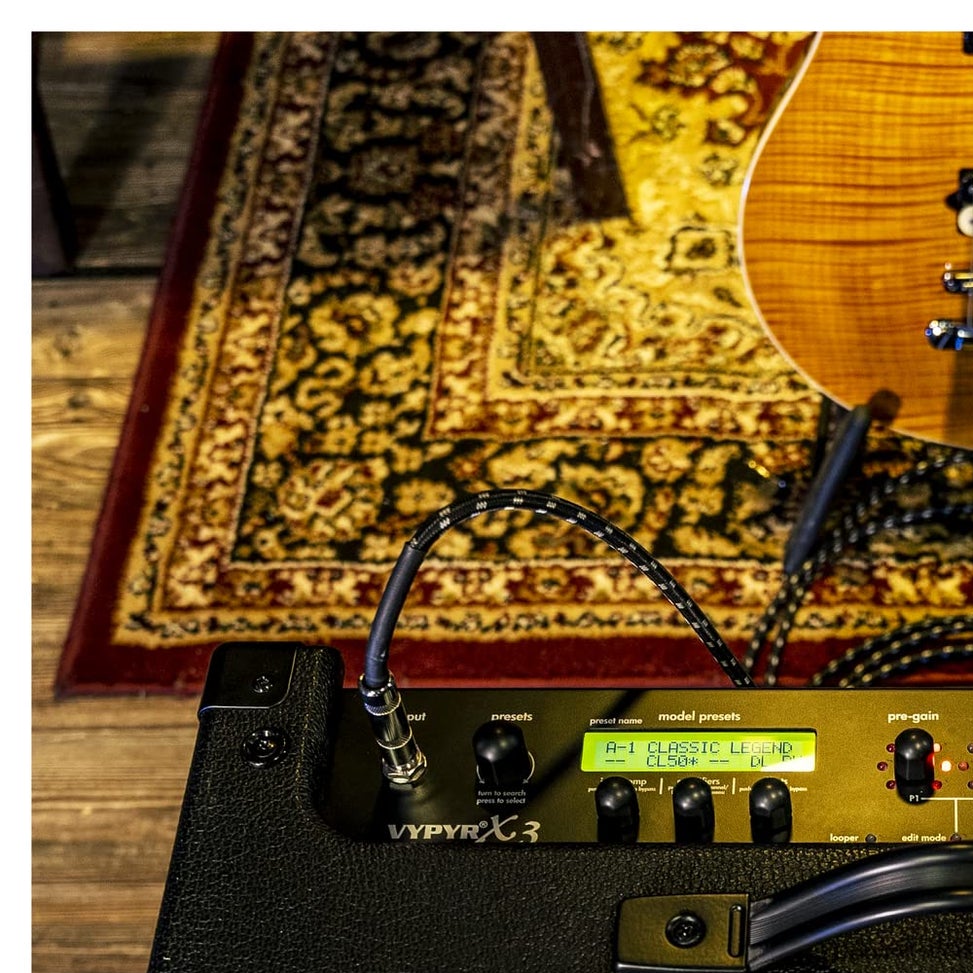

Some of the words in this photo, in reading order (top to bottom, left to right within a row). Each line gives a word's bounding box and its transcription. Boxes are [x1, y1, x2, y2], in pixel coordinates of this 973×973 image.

[491, 712, 533, 721] presets
[658, 710, 696, 721] model
[699, 711, 741, 723] presets
[887, 710, 939, 724] pre-gain
[589, 717, 616, 726] preset
[606, 741, 635, 754] A-1
[647, 741, 720, 754] CLASSIC
[730, 741, 793, 754] LEGEND
[829, 833, 859, 842] looper
[901, 833, 920, 842] edit
[922, 833, 947, 842] mode
